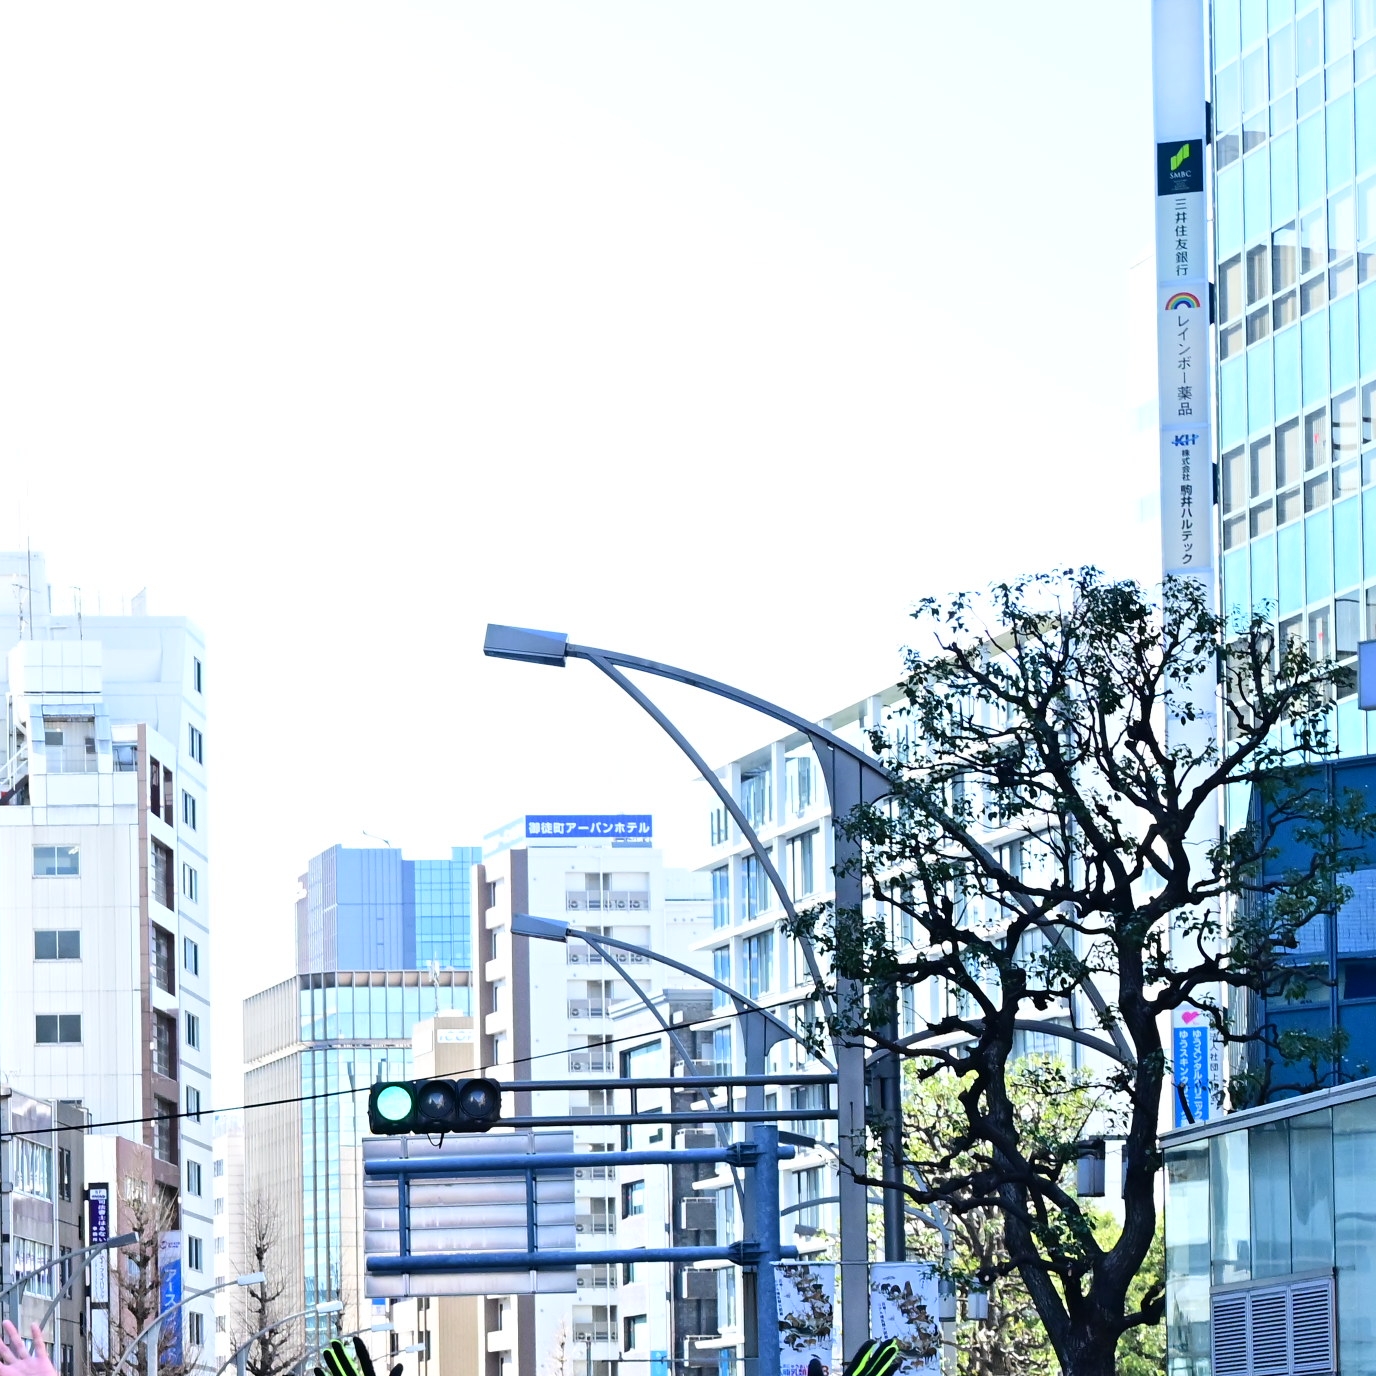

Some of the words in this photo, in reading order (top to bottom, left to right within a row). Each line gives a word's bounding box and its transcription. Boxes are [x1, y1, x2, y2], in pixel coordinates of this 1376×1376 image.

[1169, 170, 1192, 179] SMBC
[1174, 198, 1188, 276] 三井住友銀行
[1177, 314, 1192, 416] レインボー薬品
[1181, 448, 1191, 481] 株式会社
[528, 821, 650, 835] 御徒町アーバンホテル
